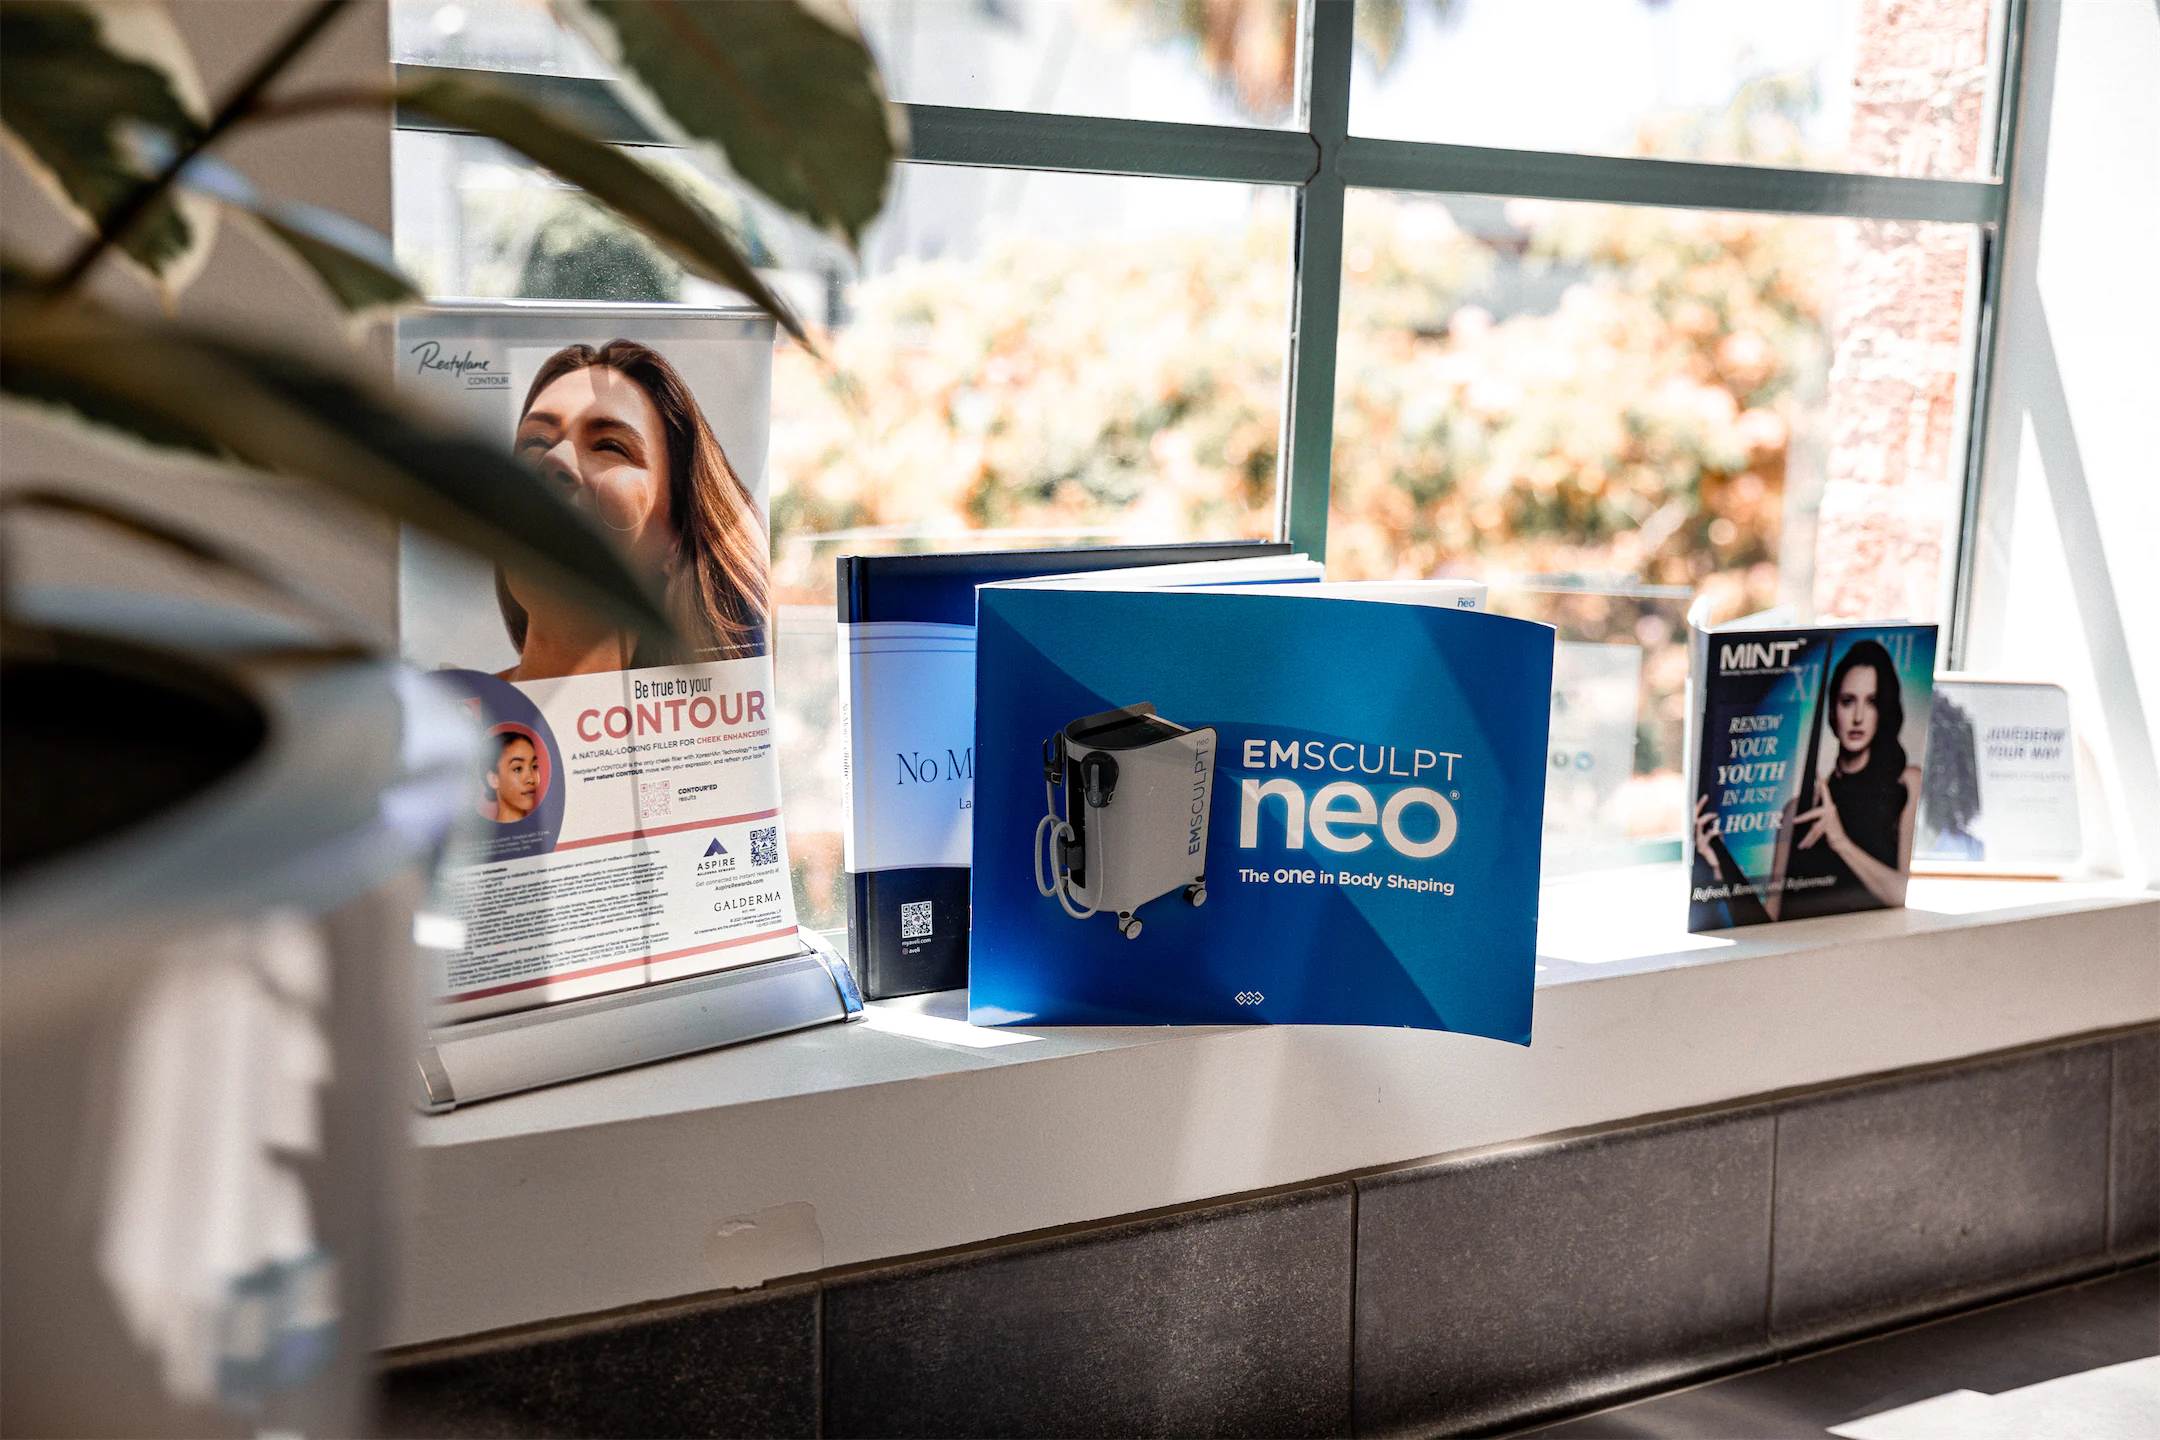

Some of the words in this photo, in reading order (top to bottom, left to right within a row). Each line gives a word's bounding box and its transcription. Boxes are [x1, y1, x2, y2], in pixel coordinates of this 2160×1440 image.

[410, 341, 490, 378] Restylane
[468, 377, 509, 385] CONTOUR
[1457, 600, 1475, 608] neo
[635, 681, 649, 700] Be
[651, 680, 674, 696] true
[676, 679, 687, 695] to
[689, 676, 712, 697] your
[577, 691, 766, 742] CONTOUR
[1728, 714, 1784, 734] RENEW
[579, 744, 651, 759] NATURAL-LOOKING
[652, 740, 678, 750] FILLER
[696, 735, 722, 745] CHEEK
[723, 728, 770, 741] ENHANCEMENT
[1196, 738, 1210, 747] neo
[1729, 736, 1779, 759] YOUR
[600, 763, 628, 772] CONTOUR
[643, 759, 655, 767] only
[655, 756, 670, 764] cheek
[896, 751, 938, 785] No
[1242, 739, 1463, 781] EMSCULPT
[1717, 761, 1787, 785] YOUTH
[1188, 748, 1209, 856] EMSCULPT
[1721, 789, 1741, 807] IN
[1740, 785, 1778, 805] JUST
[1724, 810, 1783, 834] HOUR
[697, 857, 736, 871] ASPIRE
[705, 876, 733, 886] connected
[739, 872, 757, 880] instant
[756, 869, 775, 877] rewards
[714, 879, 764, 891] AspireRewards.com
[1238, 869, 1270, 884] The
[1273, 868, 1316, 884] one
[1319, 870, 1335, 885] in
[1338, 872, 1383, 889] Body
[1387, 875, 1455, 897] Shaping
[713, 891, 781, 912] GALDERMA
